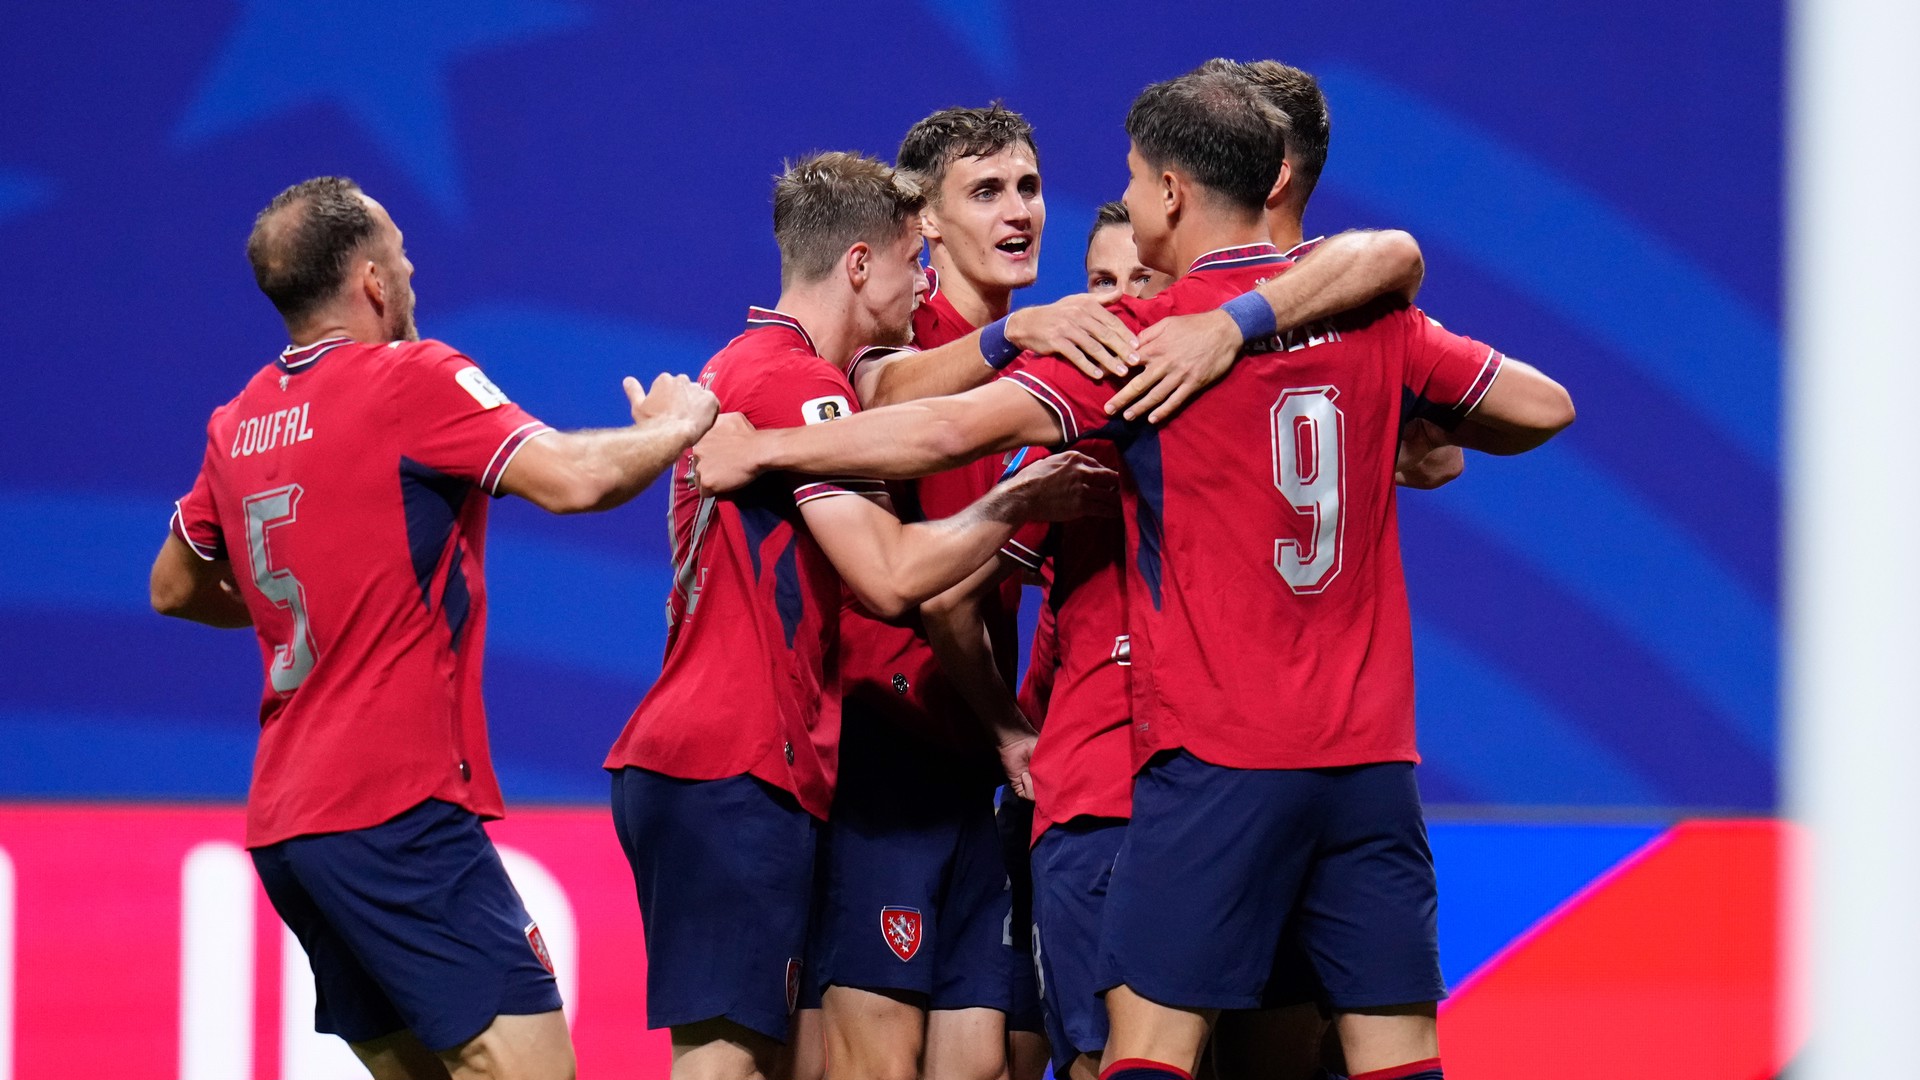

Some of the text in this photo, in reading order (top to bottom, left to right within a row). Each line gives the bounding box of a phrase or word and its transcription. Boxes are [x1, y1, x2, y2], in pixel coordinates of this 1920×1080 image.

[231, 402, 314, 458] COUFAL
[1270, 385, 1346, 595] 9
[242, 483, 320, 699] 5
